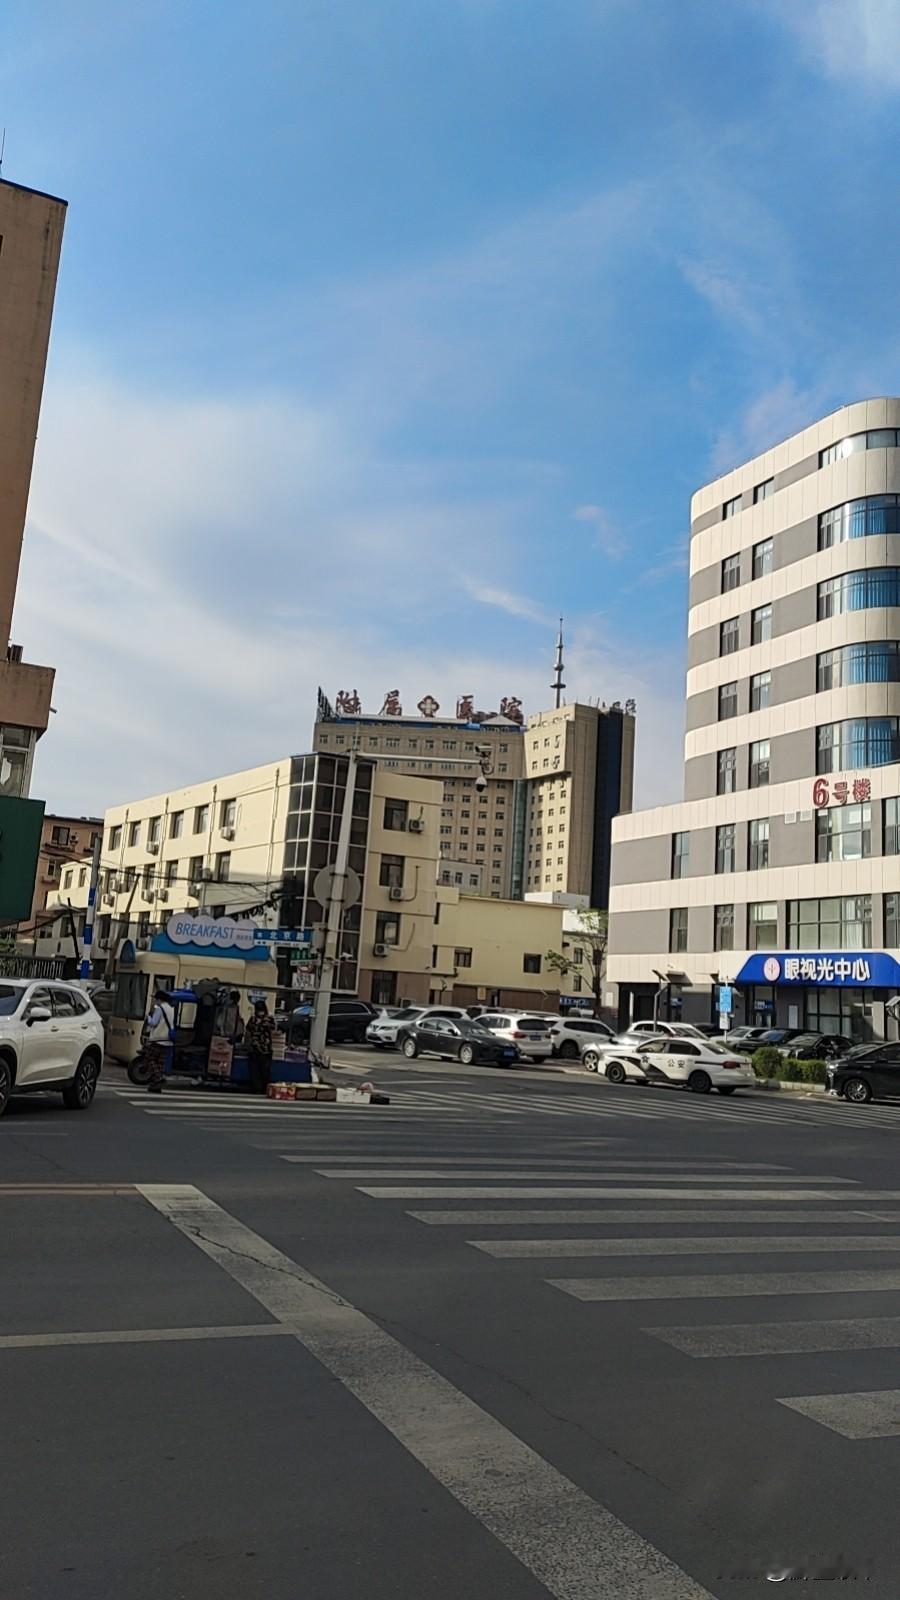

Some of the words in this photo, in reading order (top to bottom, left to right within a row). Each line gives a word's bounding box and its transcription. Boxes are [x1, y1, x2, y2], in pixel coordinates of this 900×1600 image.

[813, 778, 871, 808] 6号楼
[175, 922, 236, 940] BREAKFAST
[784, 957, 870, 981] 眼视光中心
[667, 1058, 686, 1069] 公安
